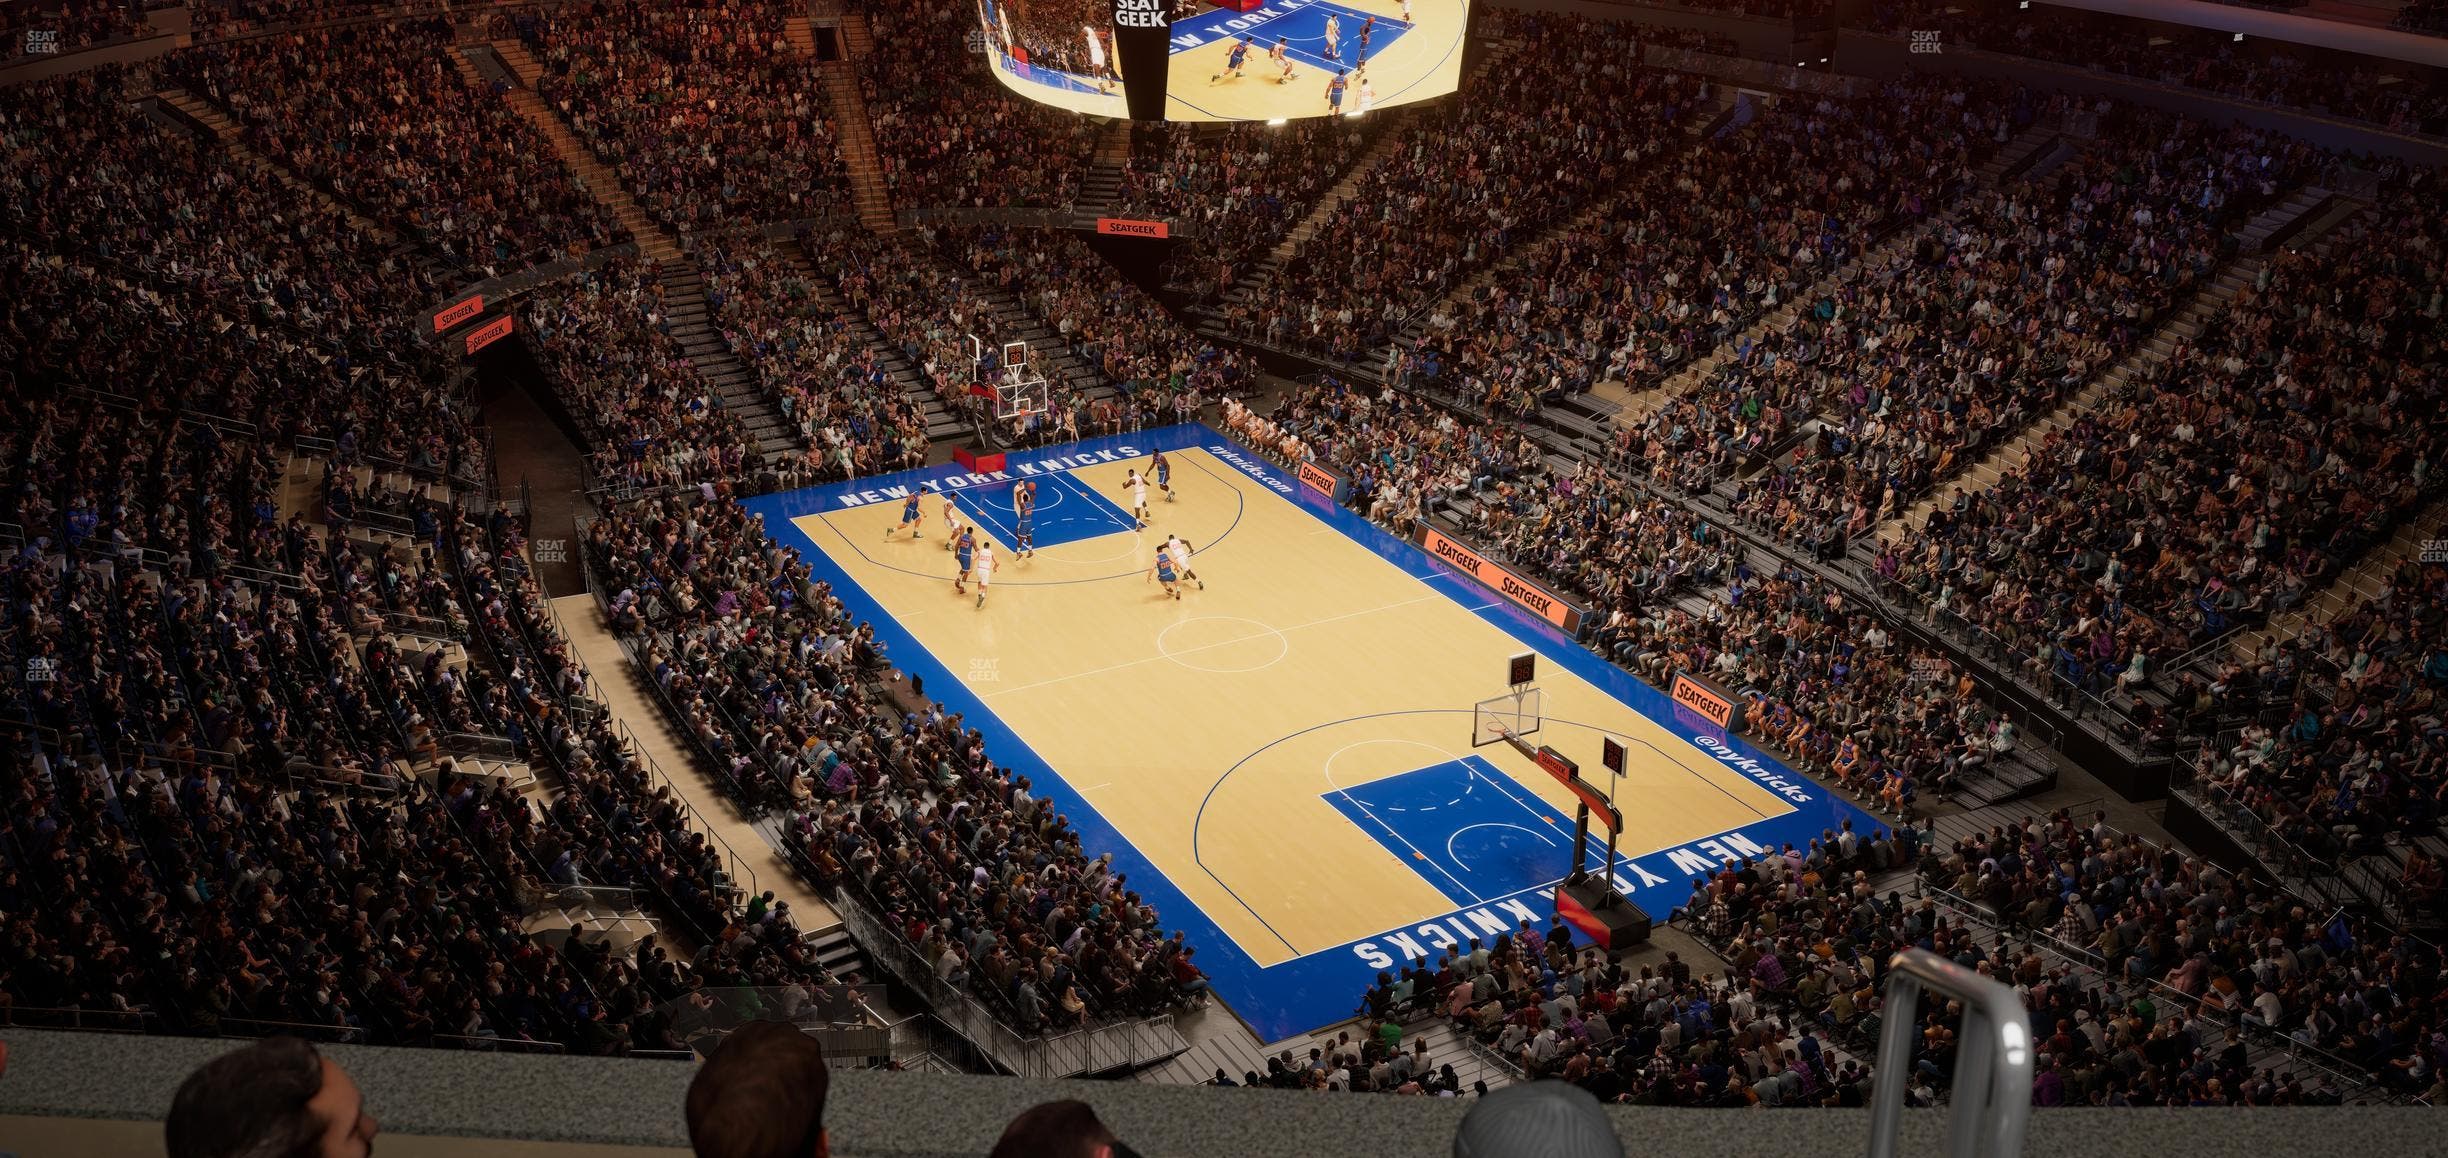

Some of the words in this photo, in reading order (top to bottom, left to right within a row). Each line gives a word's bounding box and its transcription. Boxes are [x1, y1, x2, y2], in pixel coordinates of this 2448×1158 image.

[1115, 10, 1167, 28] GEEK
[1204, 7, 1283, 35] YORK
[1110, 223, 1156, 235] SEATGEEK
[441, 303, 475, 326] SEATGEEK
[472, 323, 505, 348] SEATGEEK
[838, 485, 917, 507] NEW
[920, 470, 1012, 492] YORK
[1016, 446, 1142, 474] KNICKS
[1209, 445, 1293, 493] nyknicks.com
[1301, 466, 1334, 494] SEATGEEK
[1435, 539, 1482, 576] SEATGEEK
[1501, 576, 1551, 616] SEATGEEK
[1677, 682, 1728, 723] SEATGEEK
[1541, 753, 1566, 774] SEATGEEK
[1694, 735, 1813, 802] @nyknicks
[1666, 832, 1766, 876] NEW
[1353, 898, 1542, 969] KNICKS
